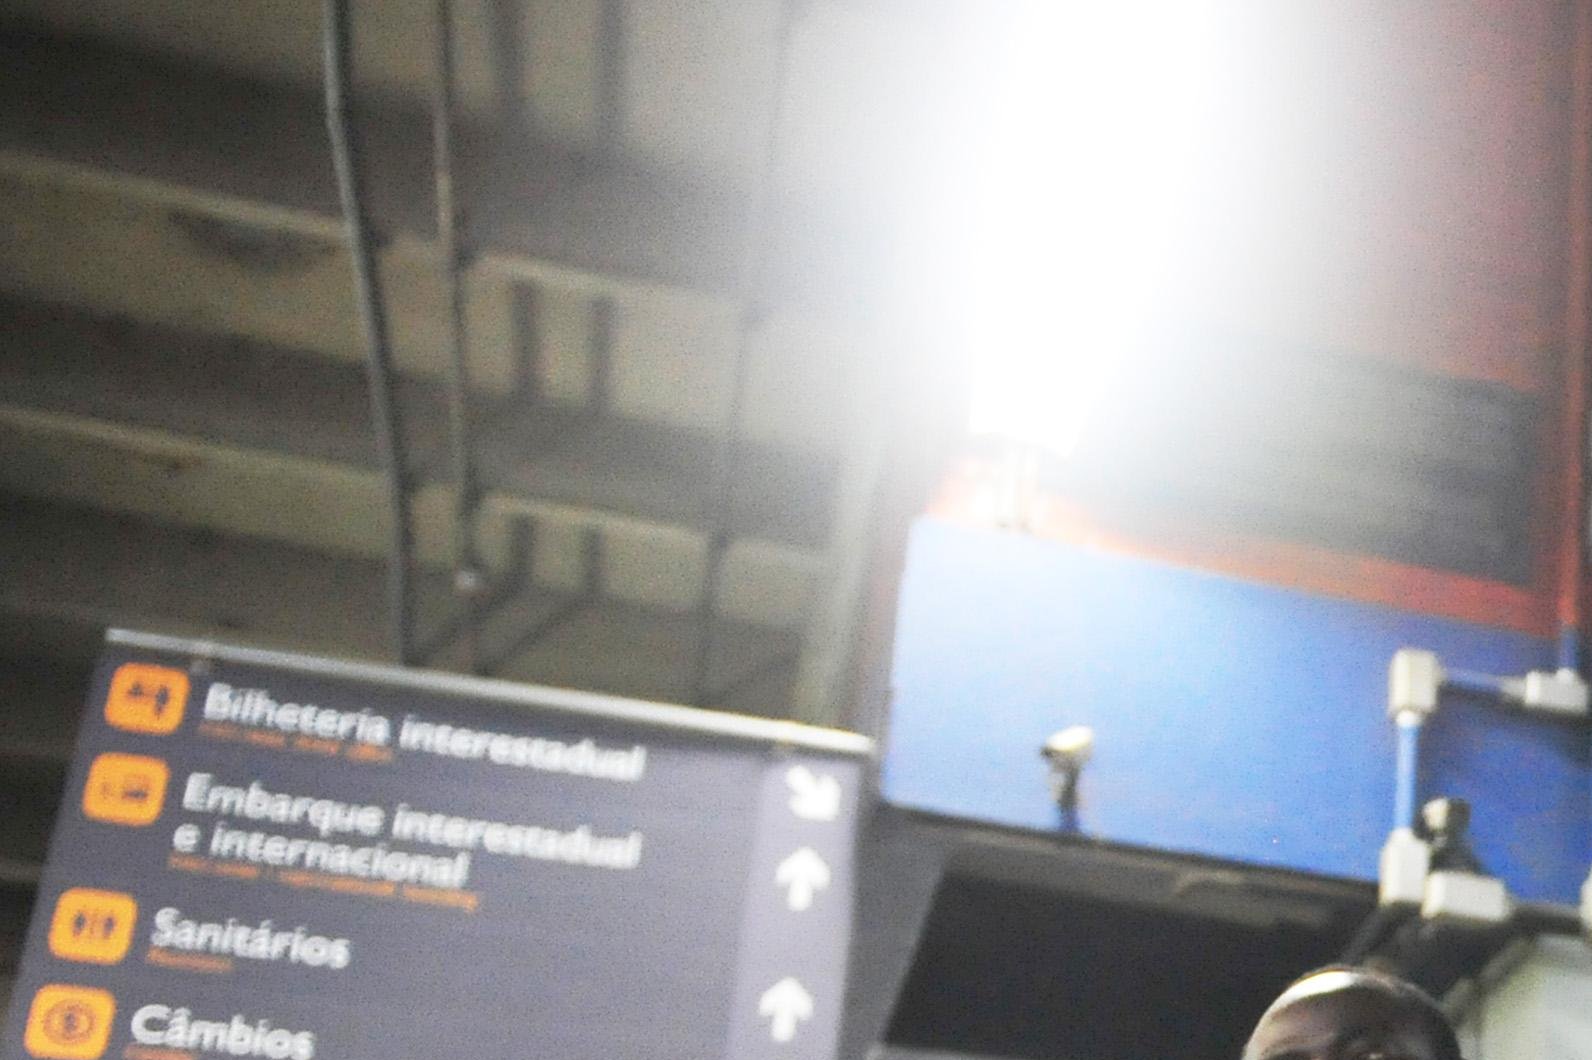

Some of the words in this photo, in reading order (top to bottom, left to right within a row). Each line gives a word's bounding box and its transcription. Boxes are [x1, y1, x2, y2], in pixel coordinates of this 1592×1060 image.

[205, 682, 390, 746] Bilheteria
[400, 714, 645, 781] interestadual
[173, 823, 201, 852] e
[211, 820, 471, 888] internacional
[183, 772, 385, 837] Embarque
[393, 803, 638, 869] interestadual
[153, 907, 351, 968] Sanitários
